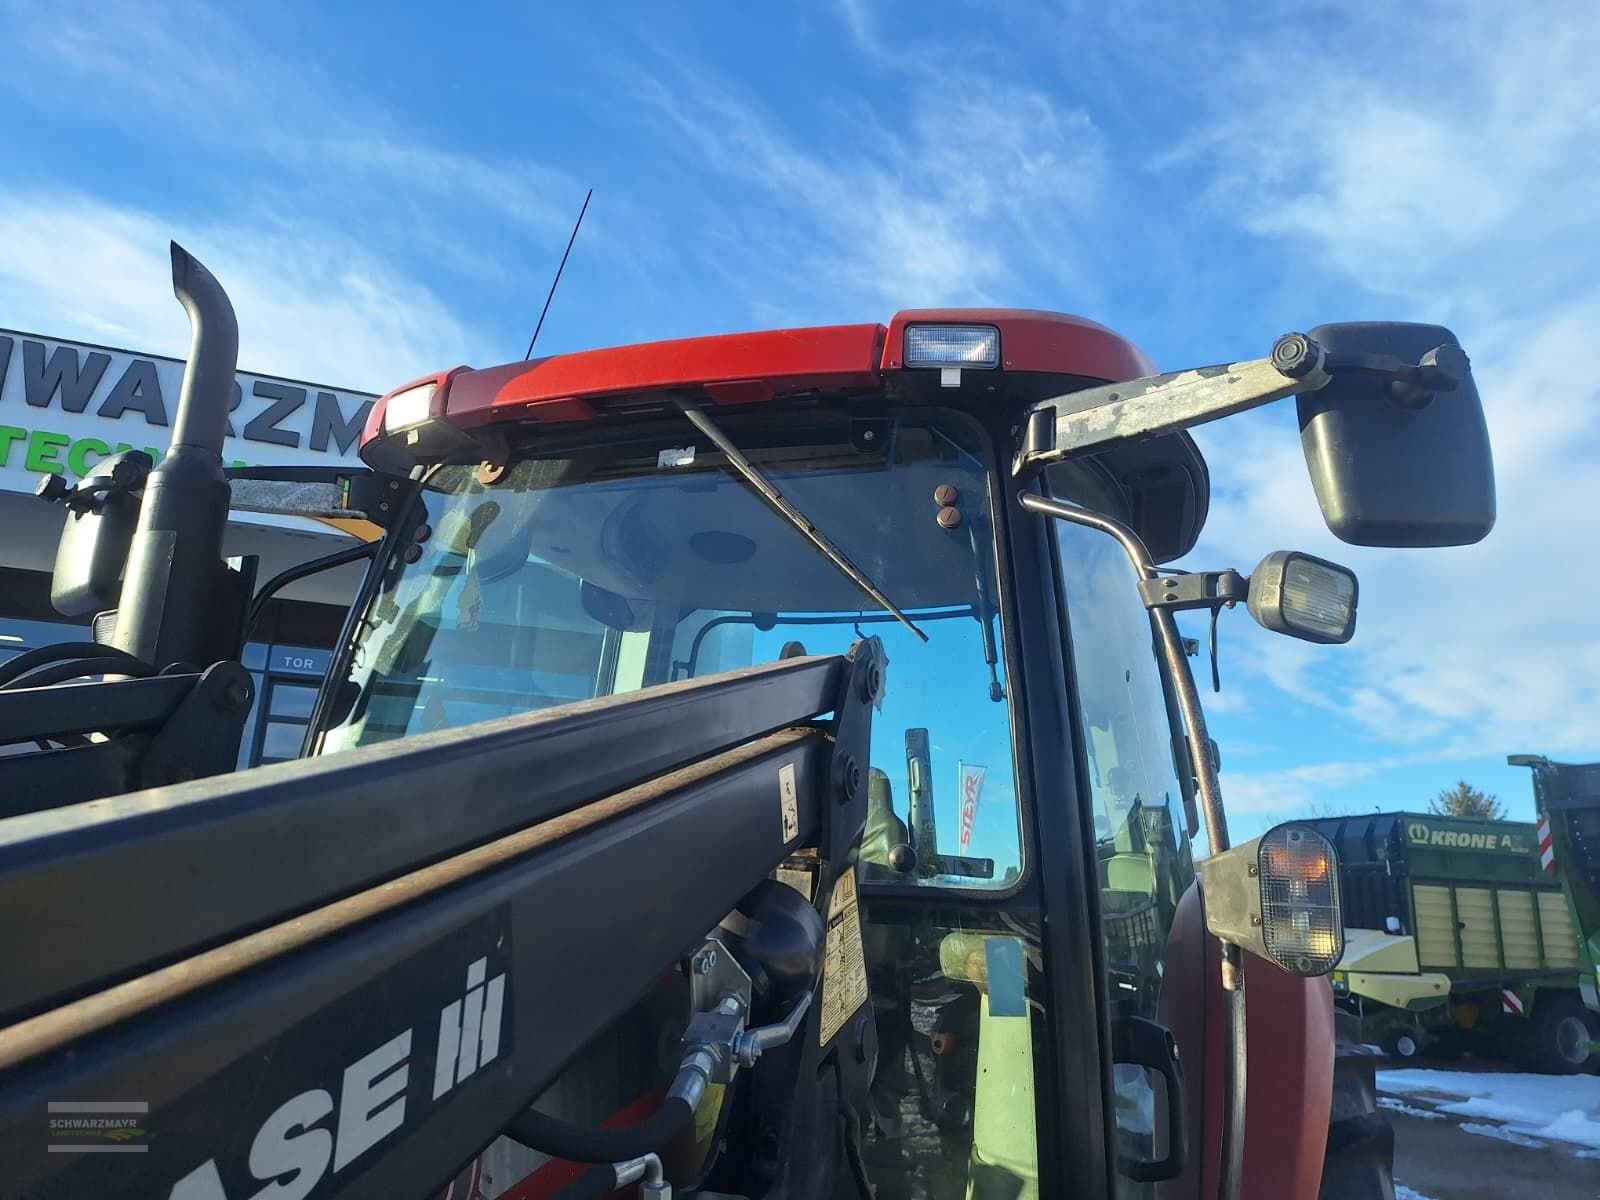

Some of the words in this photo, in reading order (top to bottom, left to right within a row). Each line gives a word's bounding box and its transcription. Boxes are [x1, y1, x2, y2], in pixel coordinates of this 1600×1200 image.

[284, 656, 314, 669] TOR
[961, 775, 980, 844] STEYR
[1431, 831, 1497, 849] KRONE
